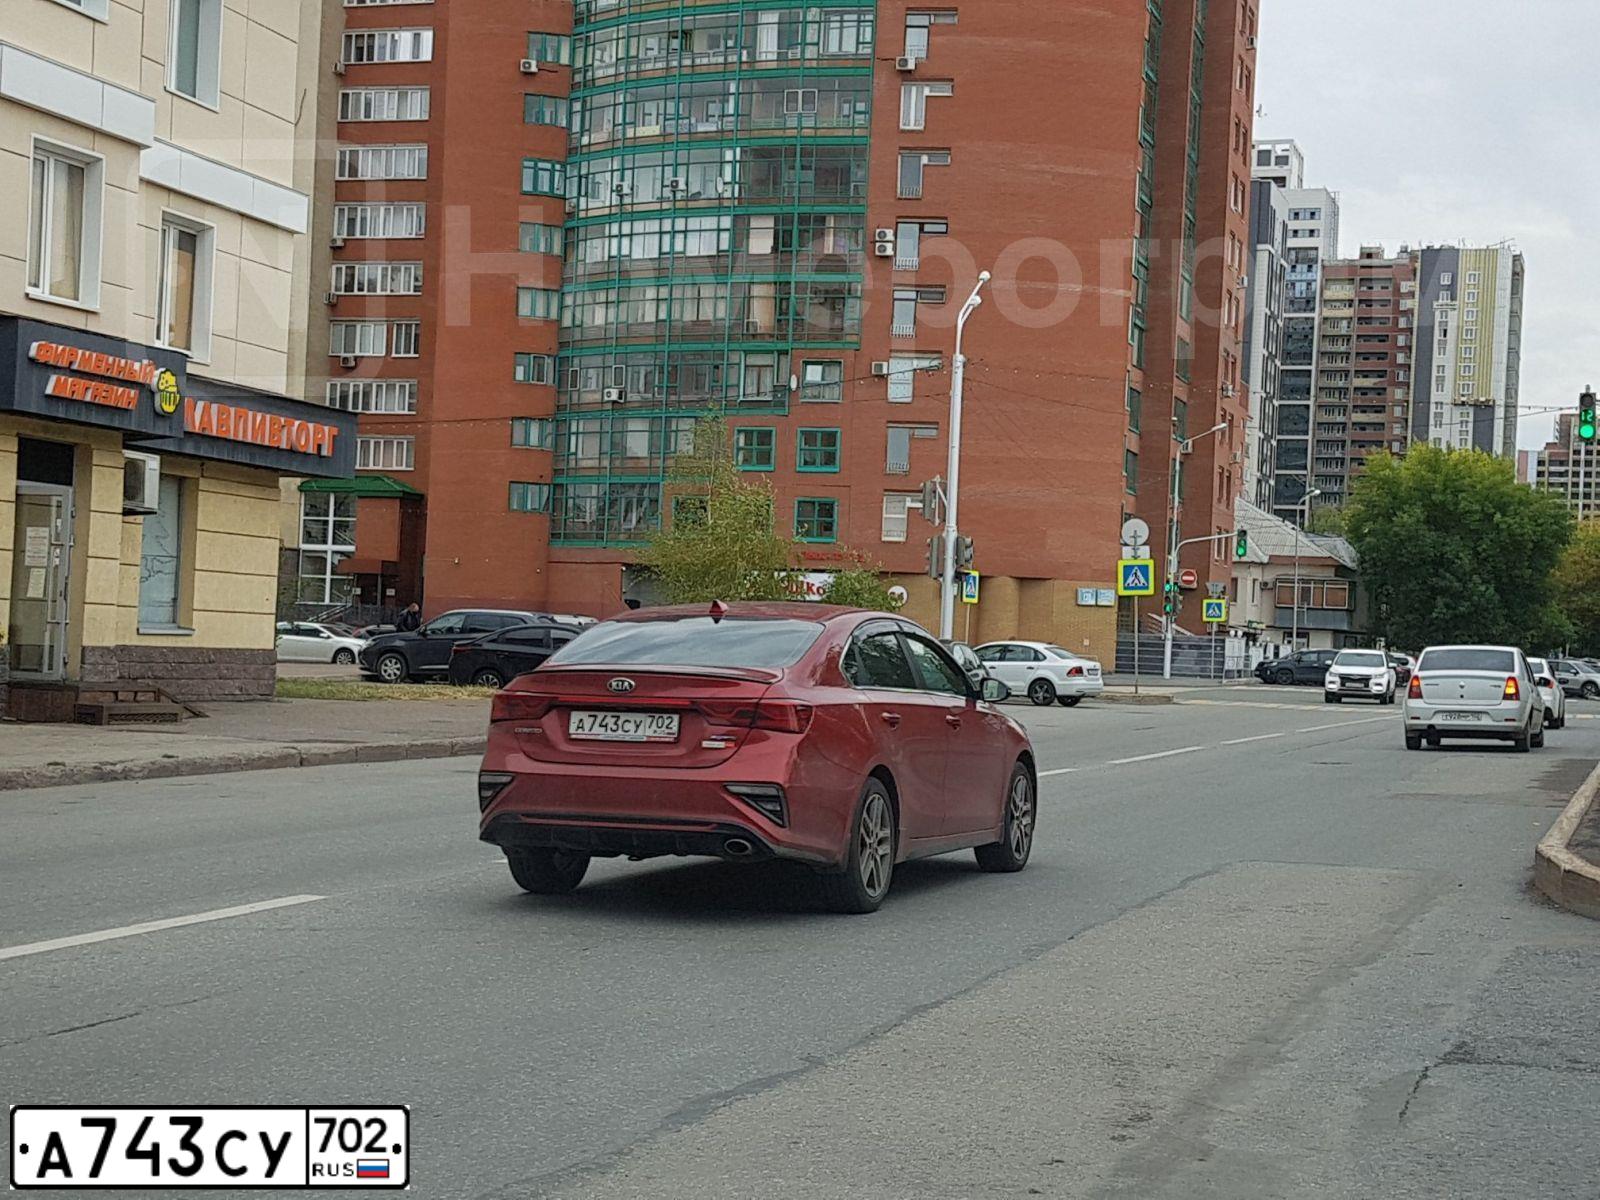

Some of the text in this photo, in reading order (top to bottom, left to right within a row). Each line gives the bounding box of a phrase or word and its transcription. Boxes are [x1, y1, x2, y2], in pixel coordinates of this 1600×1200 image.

[30, 340, 156, 384] ФИРМЕННЫЙ
[47, 374, 140, 411] МАГАЗИН
[1581, 409, 1593, 422] 12
[612, 680, 630, 691] KIA
[648, 715, 674, 730] 702
